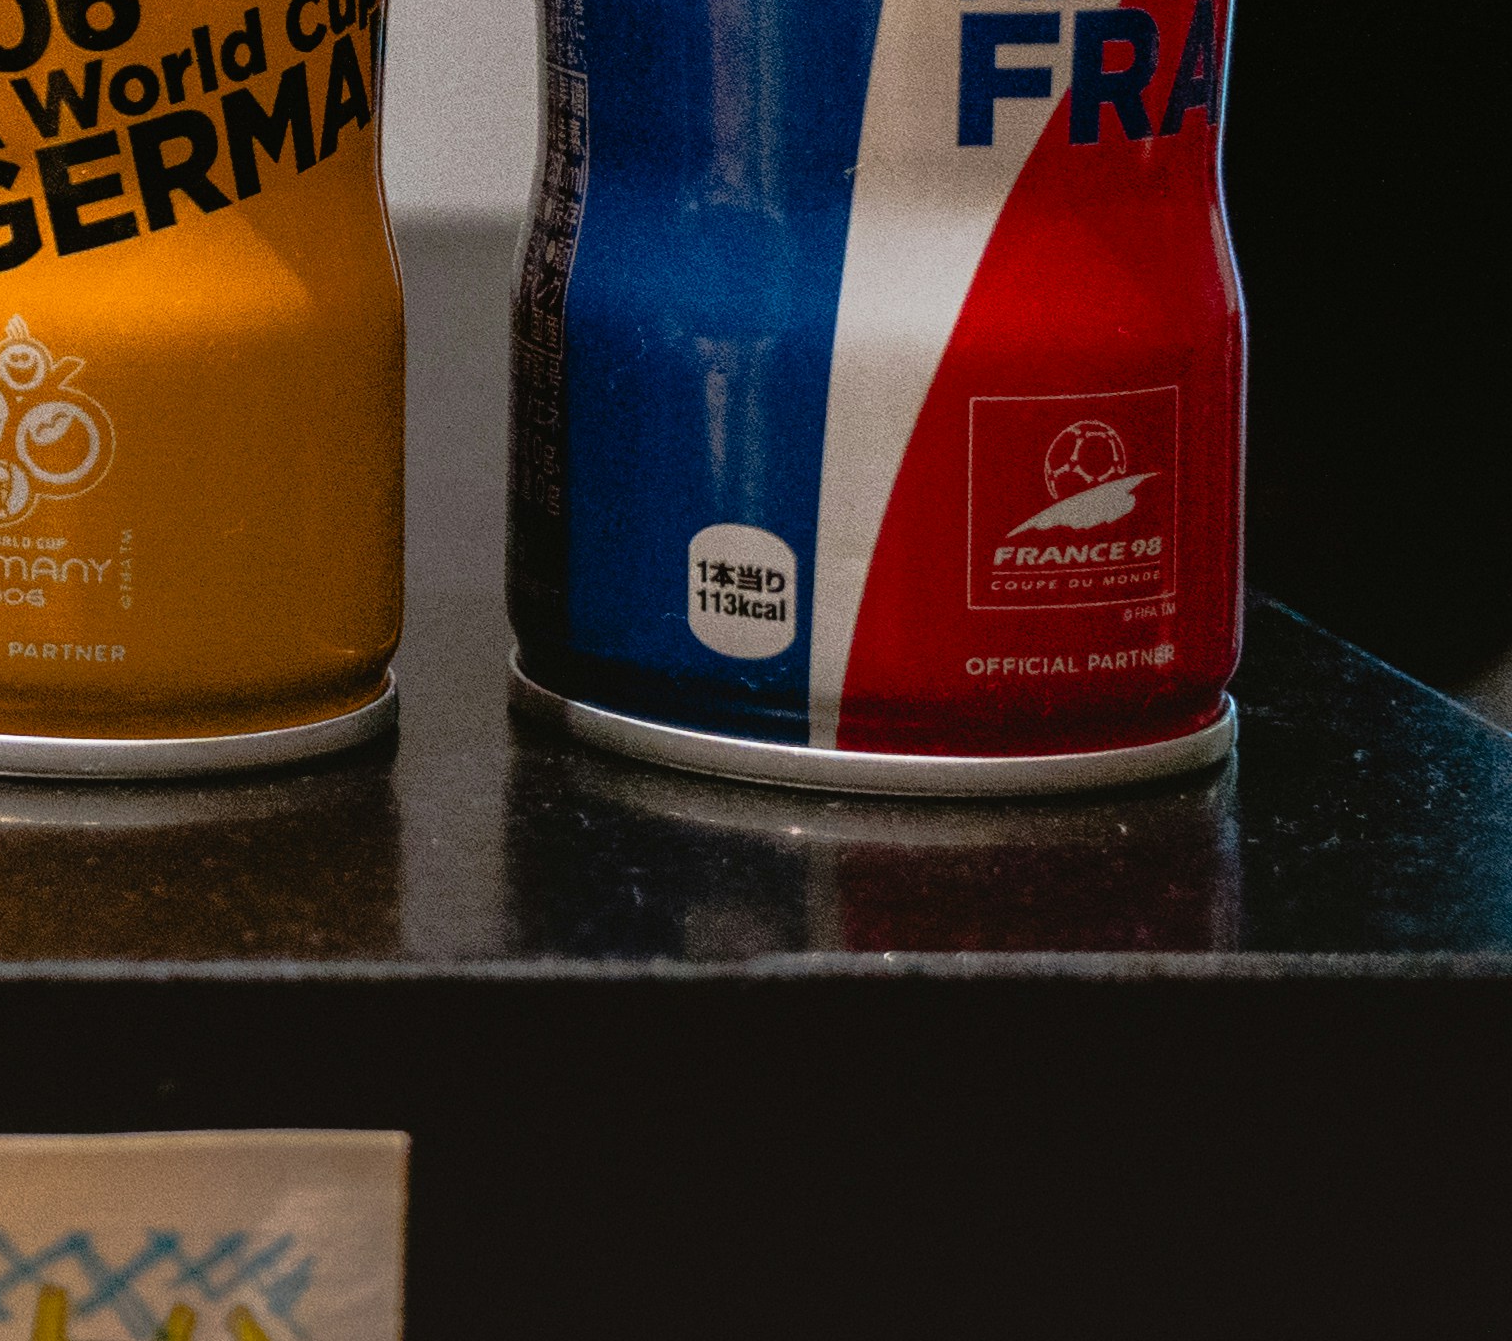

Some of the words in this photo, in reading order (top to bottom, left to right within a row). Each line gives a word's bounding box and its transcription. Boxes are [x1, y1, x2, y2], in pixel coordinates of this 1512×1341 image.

[9, 6, 268, 139] World
[992, 541, 1127, 566] FRANCE
[1130, 535, 1163, 558] 98
[695, 559, 787, 595] 1本当り
[990, 578, 1058, 592] COUPE
[1068, 577, 1094, 589] DU
[1102, 569, 1161, 586] MONDE
[695, 589, 787, 623] 113kcal
[7, 640, 127, 663] PARTNER
[965, 656, 1080, 676] OFFICIAL
[1087, 642, 1176, 671] PARTNER
